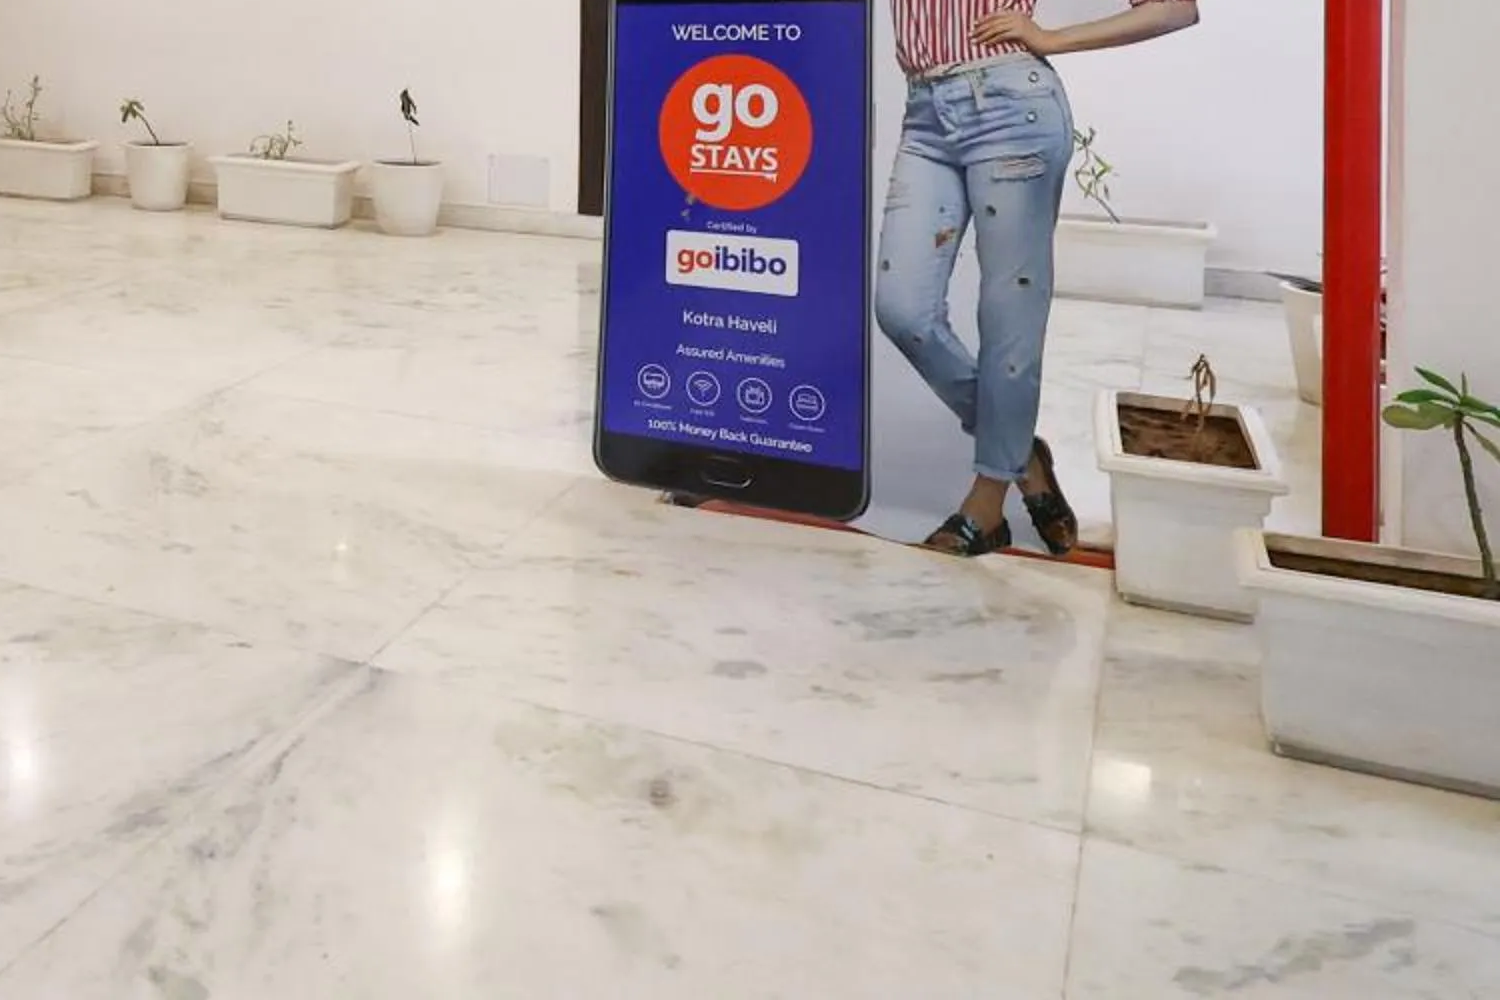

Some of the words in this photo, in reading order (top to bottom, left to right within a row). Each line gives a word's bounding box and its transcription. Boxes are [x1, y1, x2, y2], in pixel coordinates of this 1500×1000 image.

[672, 24, 769, 41] WELCOME
[774, 24, 801, 41] TO
[691, 82, 779, 142] go
[690, 144, 779, 171] STAYS
[677, 245, 787, 275] goibibo
[683, 310, 725, 328] Kotra
[727, 314, 777, 335] Haveli
[676, 343, 725, 360] Assured
[679, 420, 717, 440] Money
[719, 427, 748, 443] Back
[750, 433, 812, 453] Guarantee
